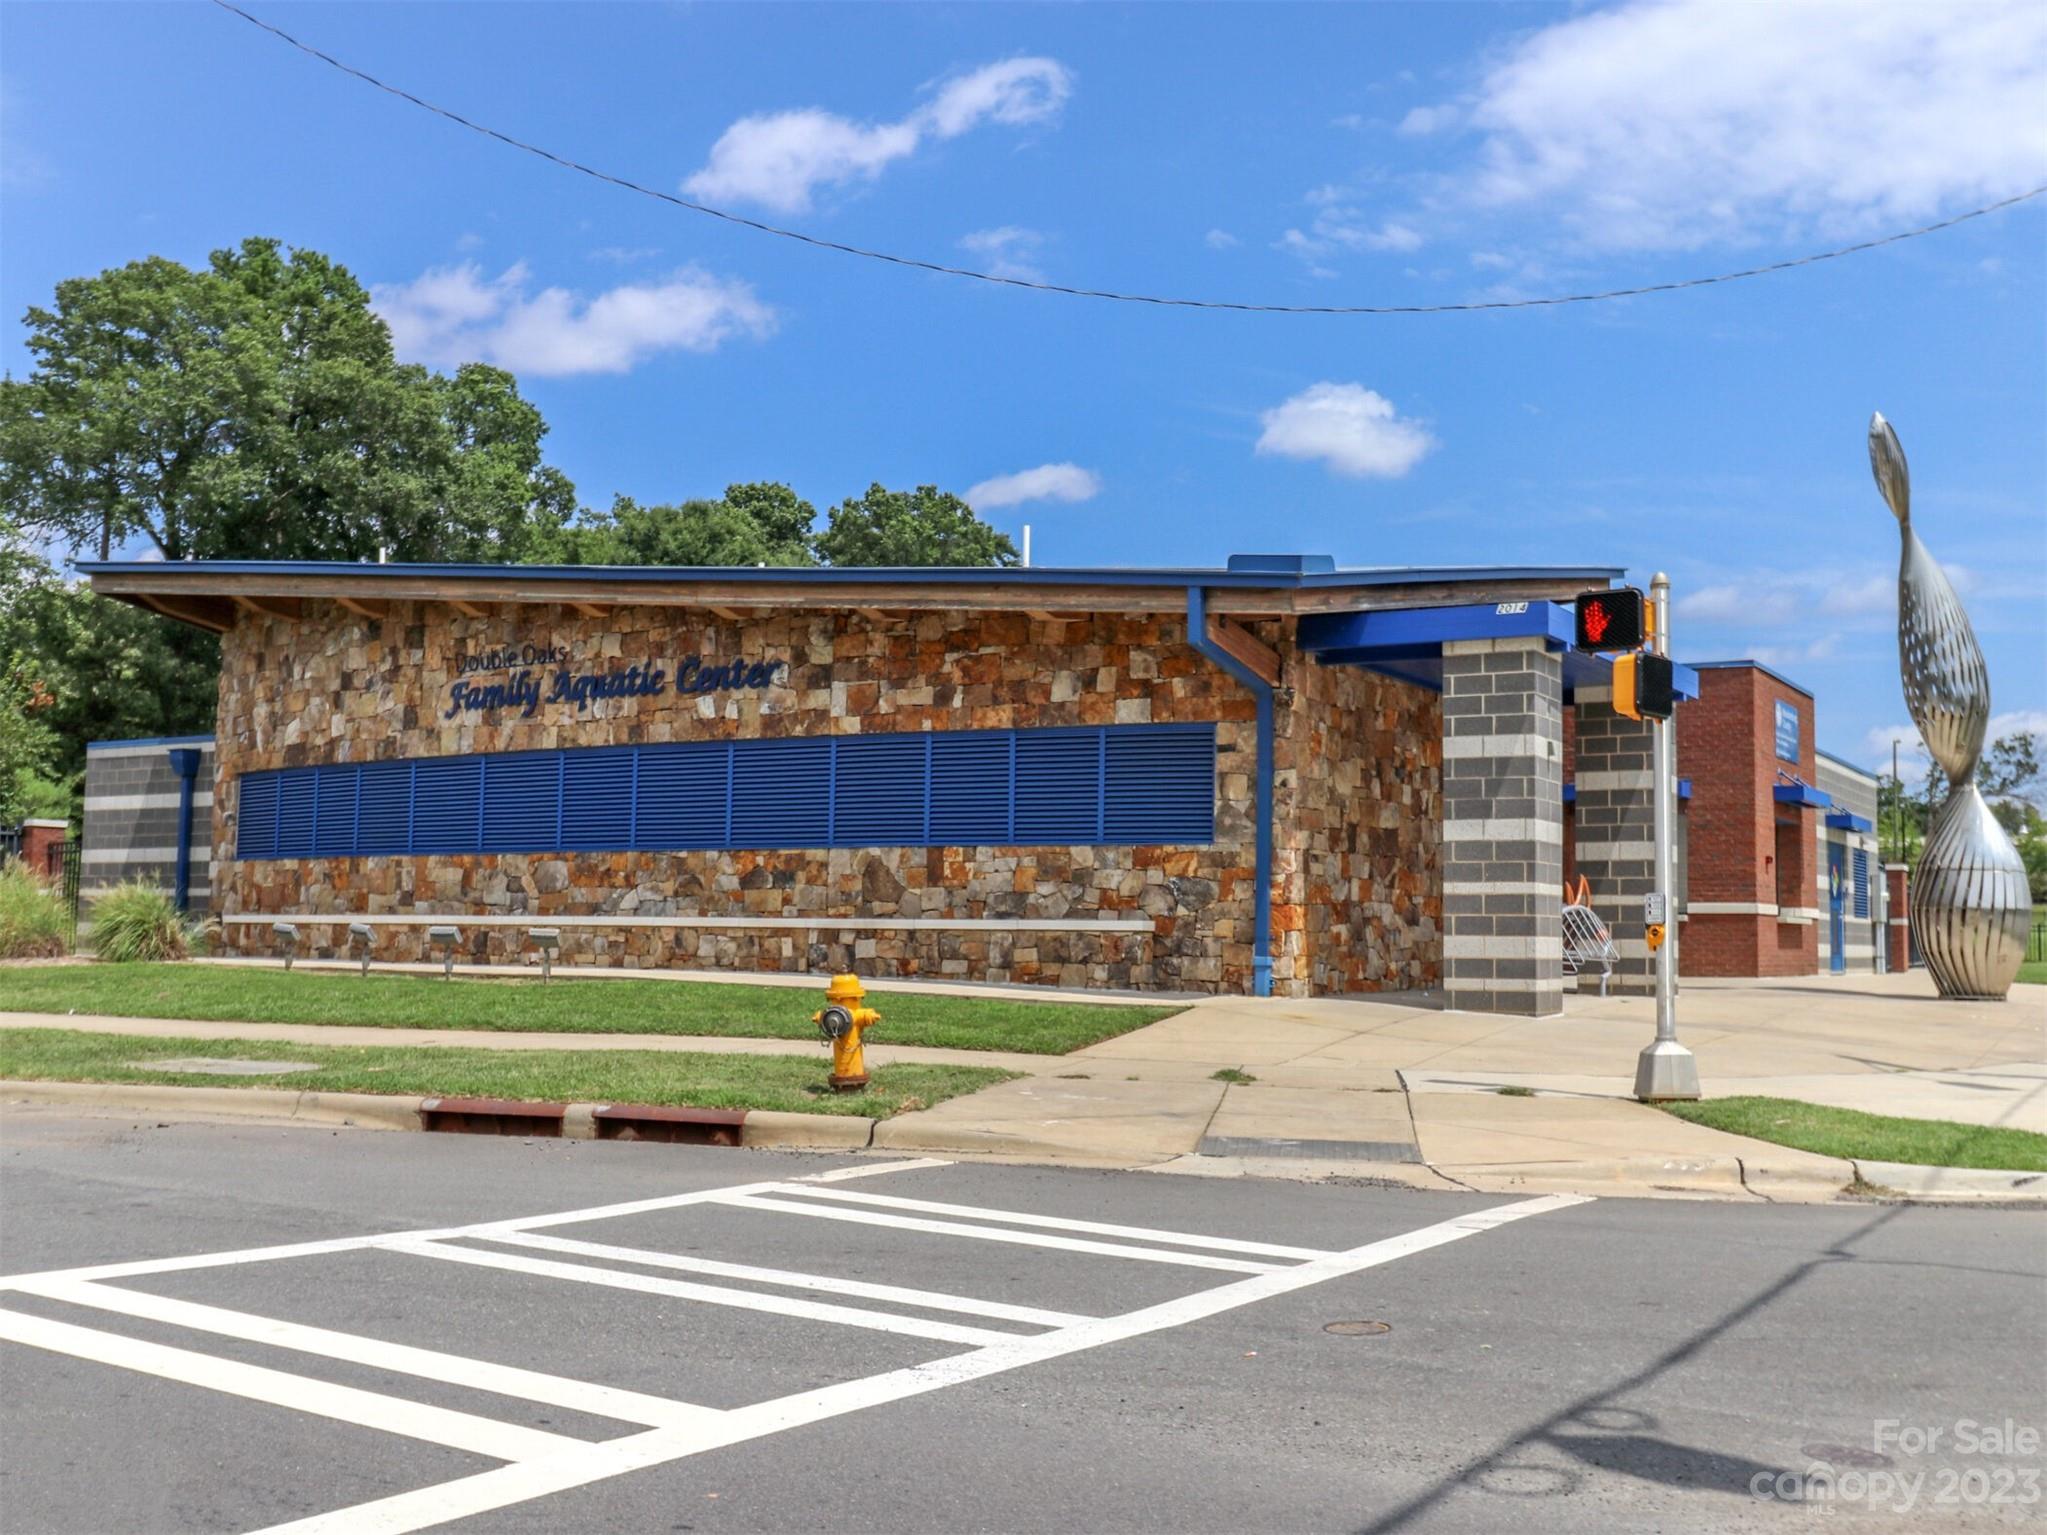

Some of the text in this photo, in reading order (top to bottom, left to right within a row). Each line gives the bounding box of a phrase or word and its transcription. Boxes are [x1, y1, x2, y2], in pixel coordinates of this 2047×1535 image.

[455, 642, 568, 672] Double Oaks
[444, 656, 786, 720] Family Aquatic Center
